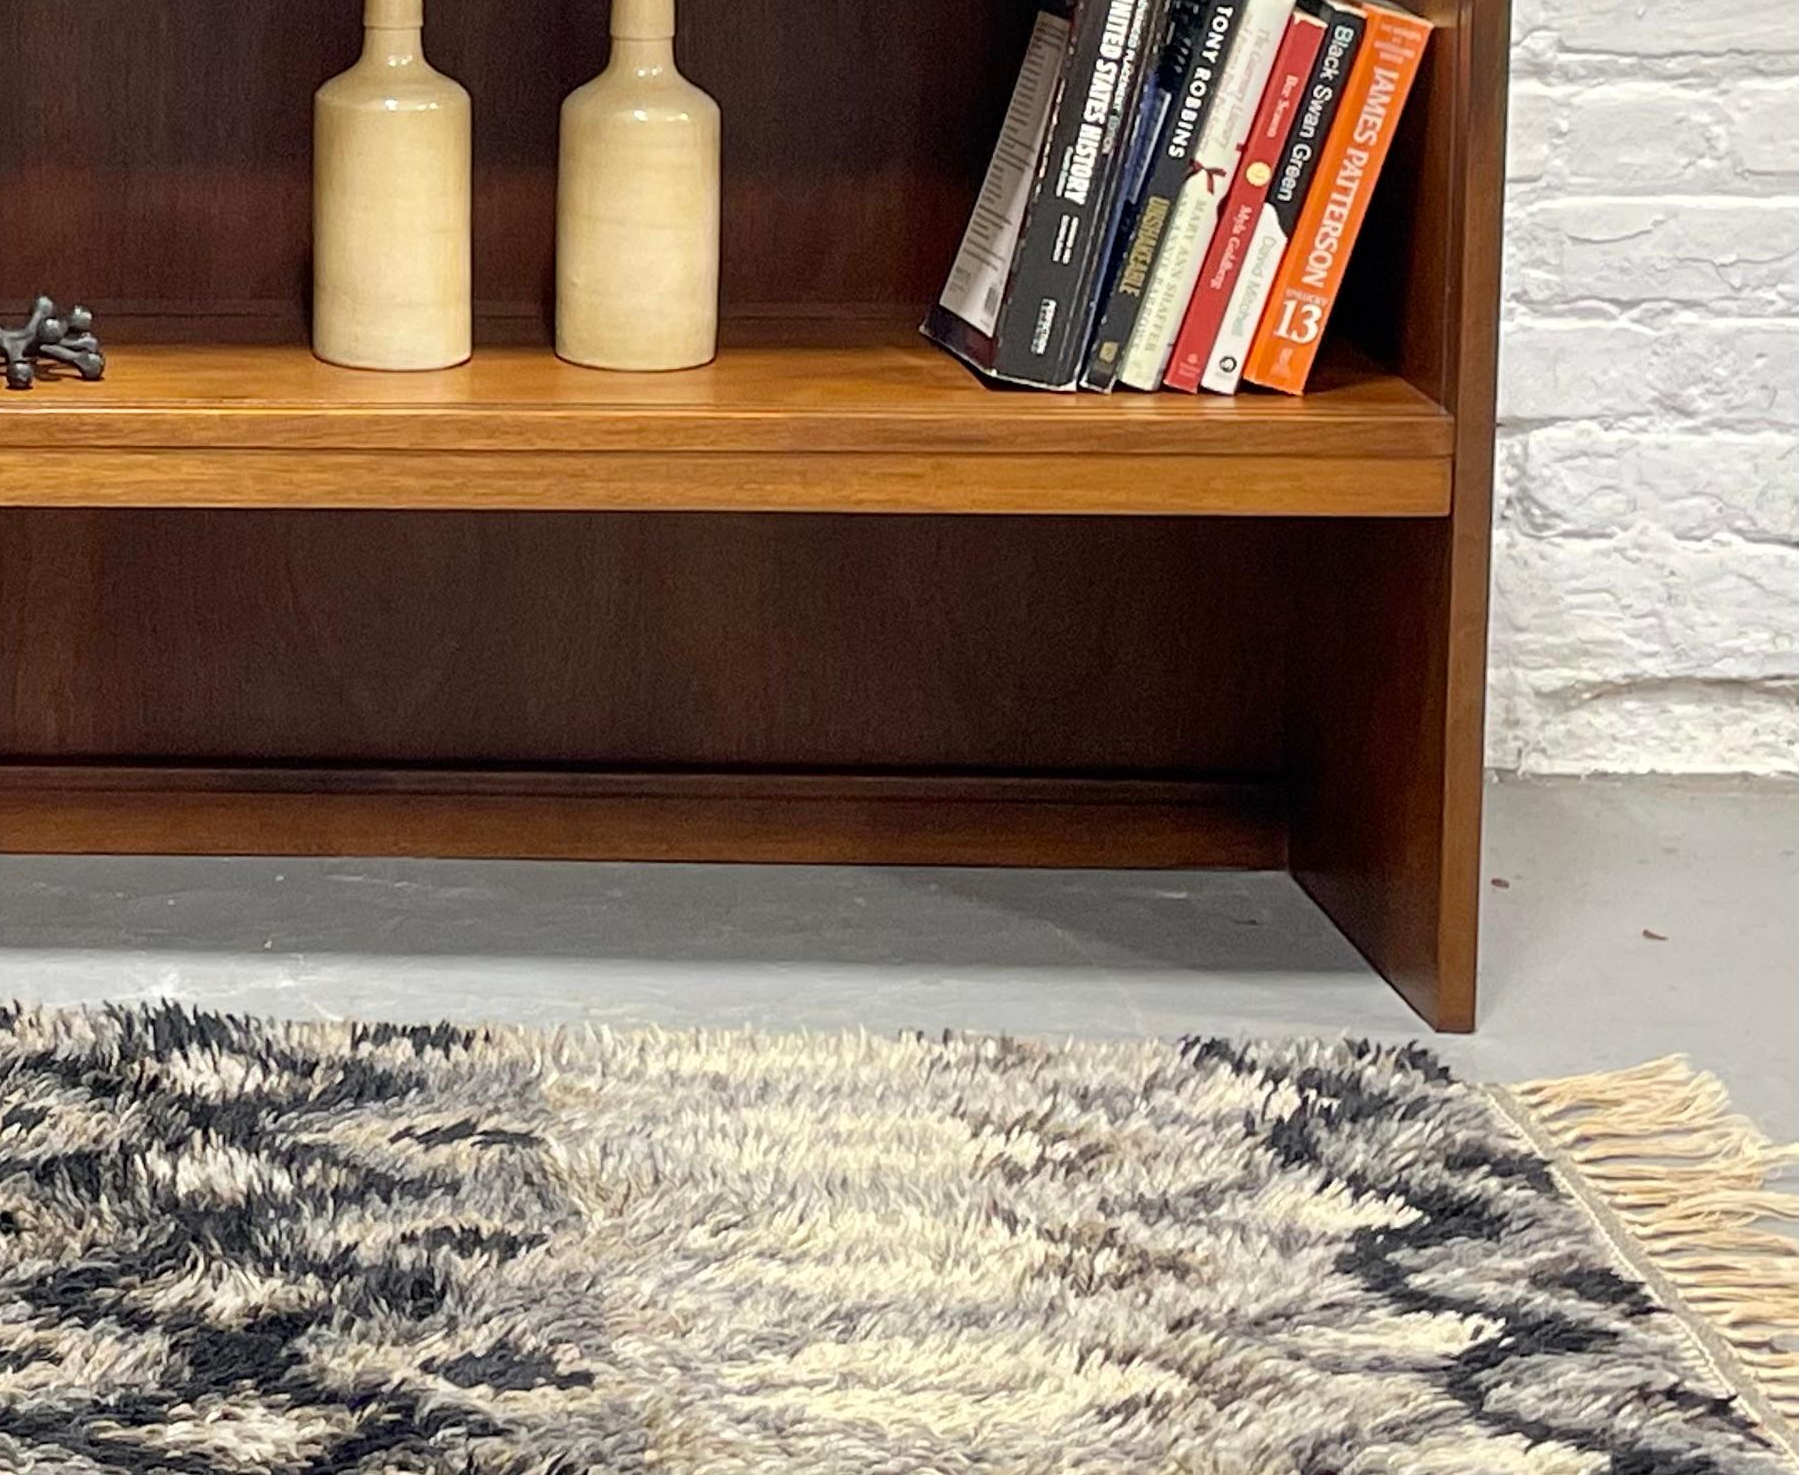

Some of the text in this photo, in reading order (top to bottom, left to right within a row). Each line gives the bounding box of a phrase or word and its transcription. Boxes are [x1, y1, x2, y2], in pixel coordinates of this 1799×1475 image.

[1083, 58, 1119, 124] STATES
[1168, 6, 1234, 158] TONY ROBBINS
[1277, 26, 1354, 202] Black Swan Green
[1281, 75, 1299, 97] Bee
[1353, 66, 1400, 146] JAMES
[1064, 123, 1102, 205] HISTORY
[1119, 196, 1170, 297] UNSHAKEABLE
[1210, 205, 1252, 290] Myla Goldberg
[1301, 147, 1370, 289] PATTERSON
[1143, 281, 1179, 354] SHAFFER
[1231, 236, 1277, 336] David Mitchell
[1274, 299, 1323, 345] 13
